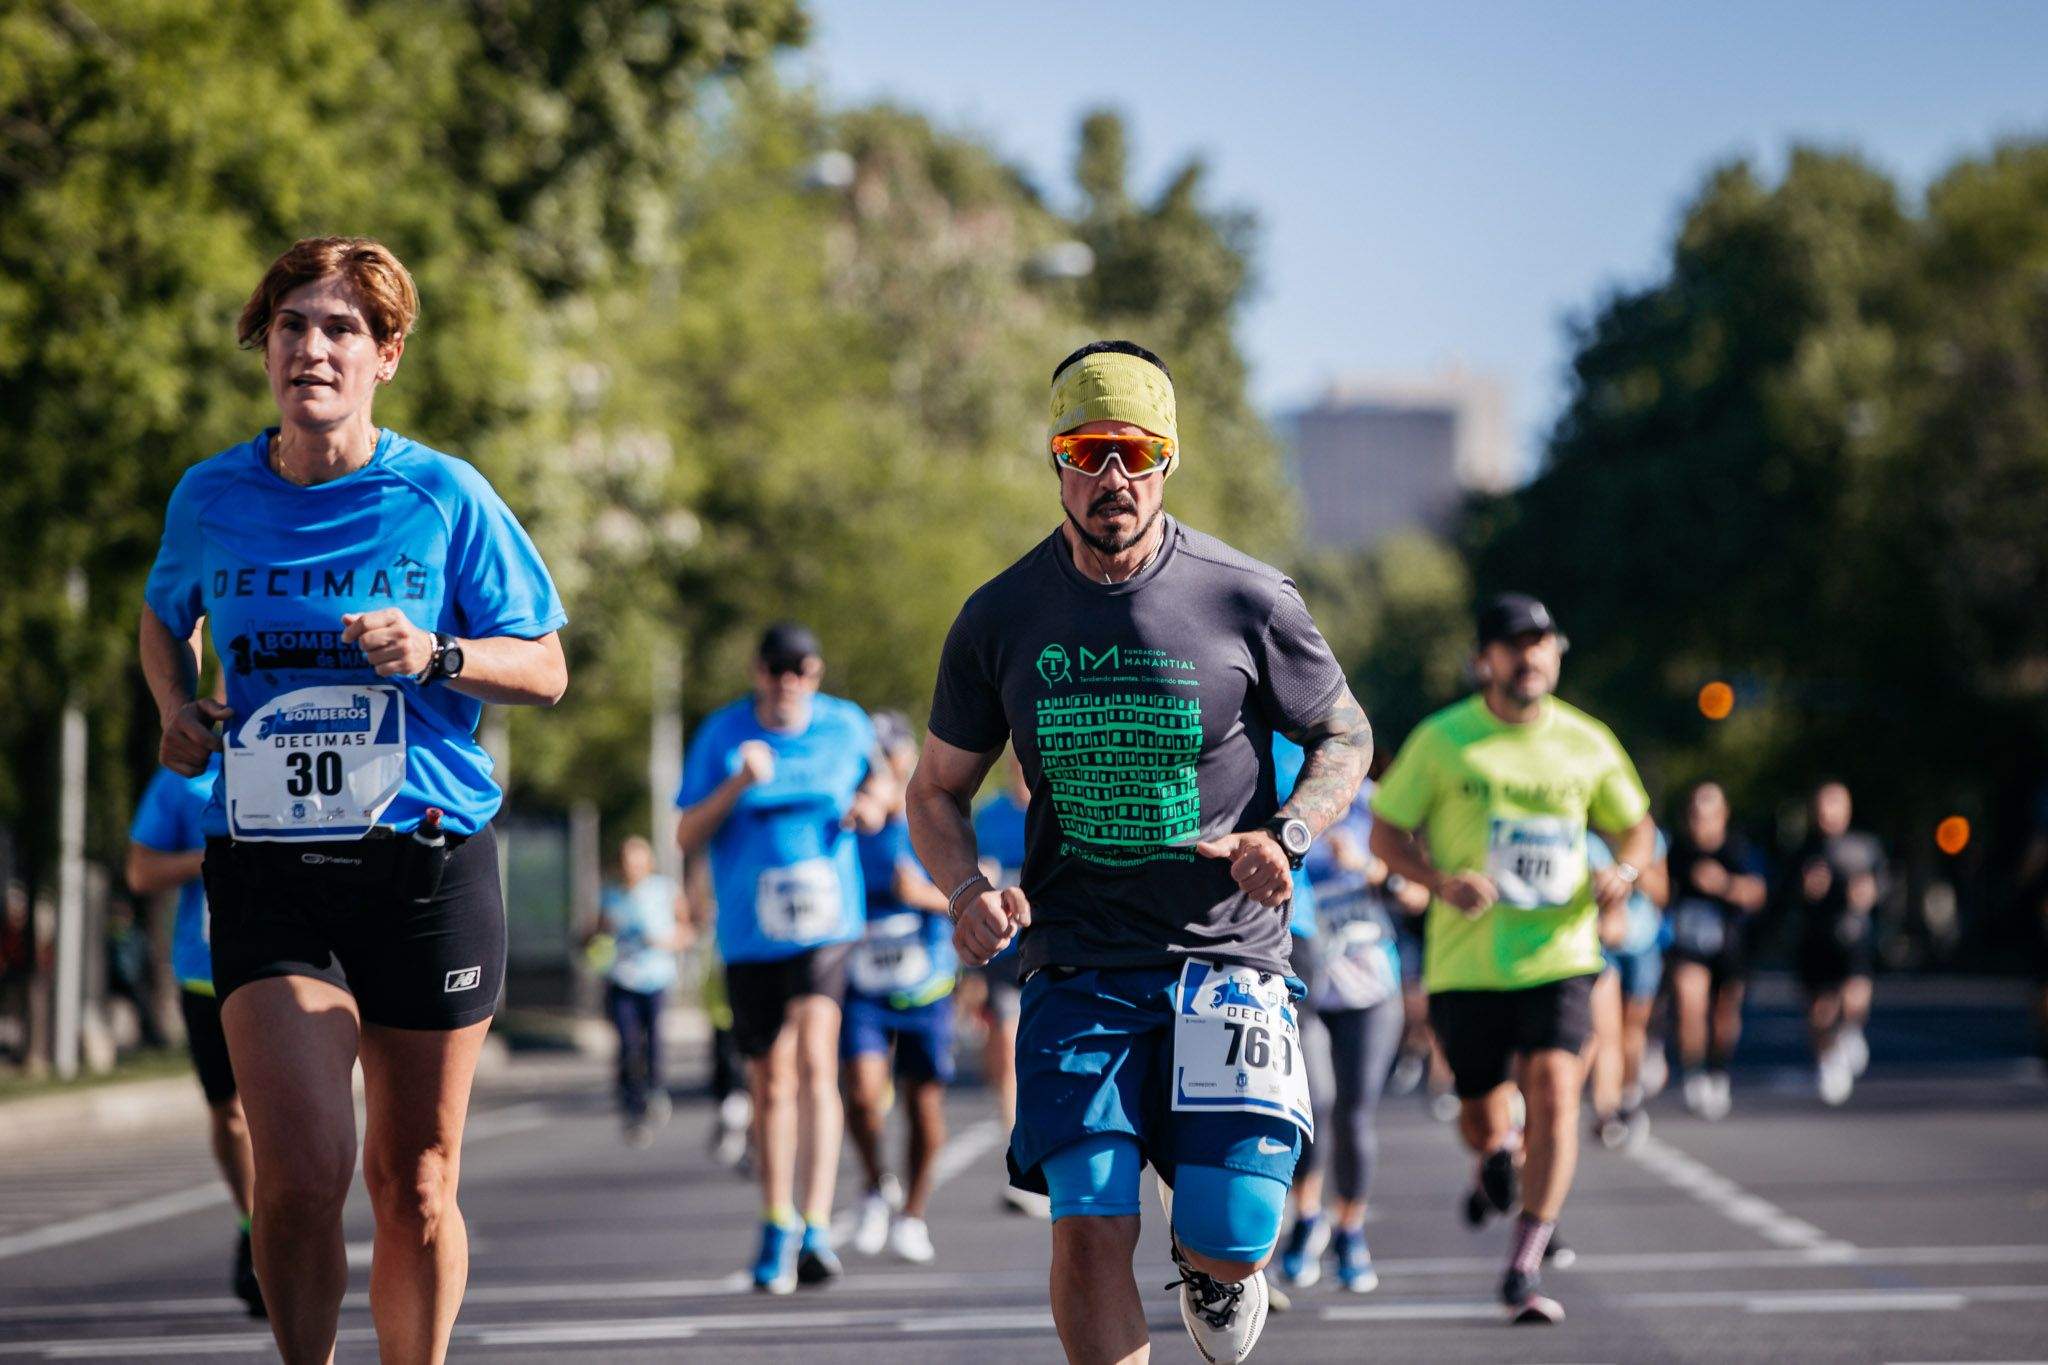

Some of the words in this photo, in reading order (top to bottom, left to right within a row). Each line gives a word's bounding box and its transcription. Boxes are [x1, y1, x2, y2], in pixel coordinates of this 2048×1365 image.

[214, 568, 428, 600] DECIMAS
[264, 632, 358, 650] BOMBE
[1124, 658, 1196, 670] MANANTIAL
[285, 707, 368, 722] BOMBEROS
[275, 733, 367, 749] DECIMAS
[286, 751, 343, 797] 30
